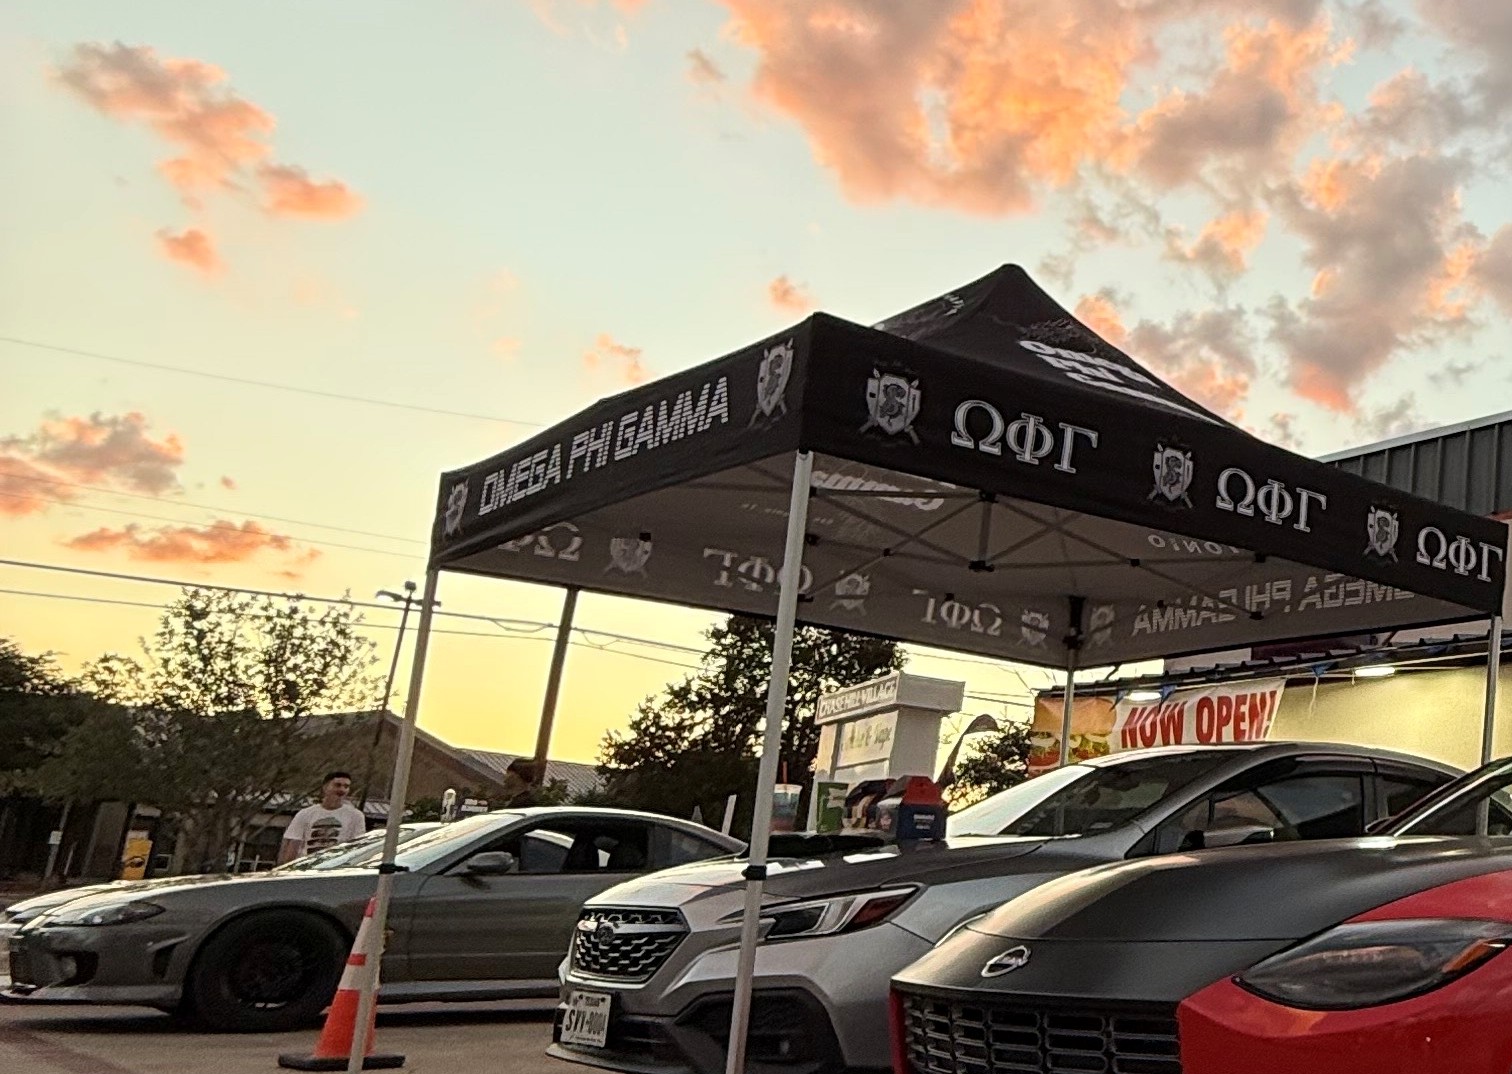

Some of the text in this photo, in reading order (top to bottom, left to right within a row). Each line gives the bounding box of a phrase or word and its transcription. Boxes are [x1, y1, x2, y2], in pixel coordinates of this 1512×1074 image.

[478, 375, 730, 516] OMEGA PHI GAMMA
[950, 399, 1099, 475] ΩΦΓ
[1216, 467, 1328, 533] ΩΦΓ
[1416, 526, 1503, 583] ΩΦΓ
[1120, 690, 1278, 748] NOW OPEN!
